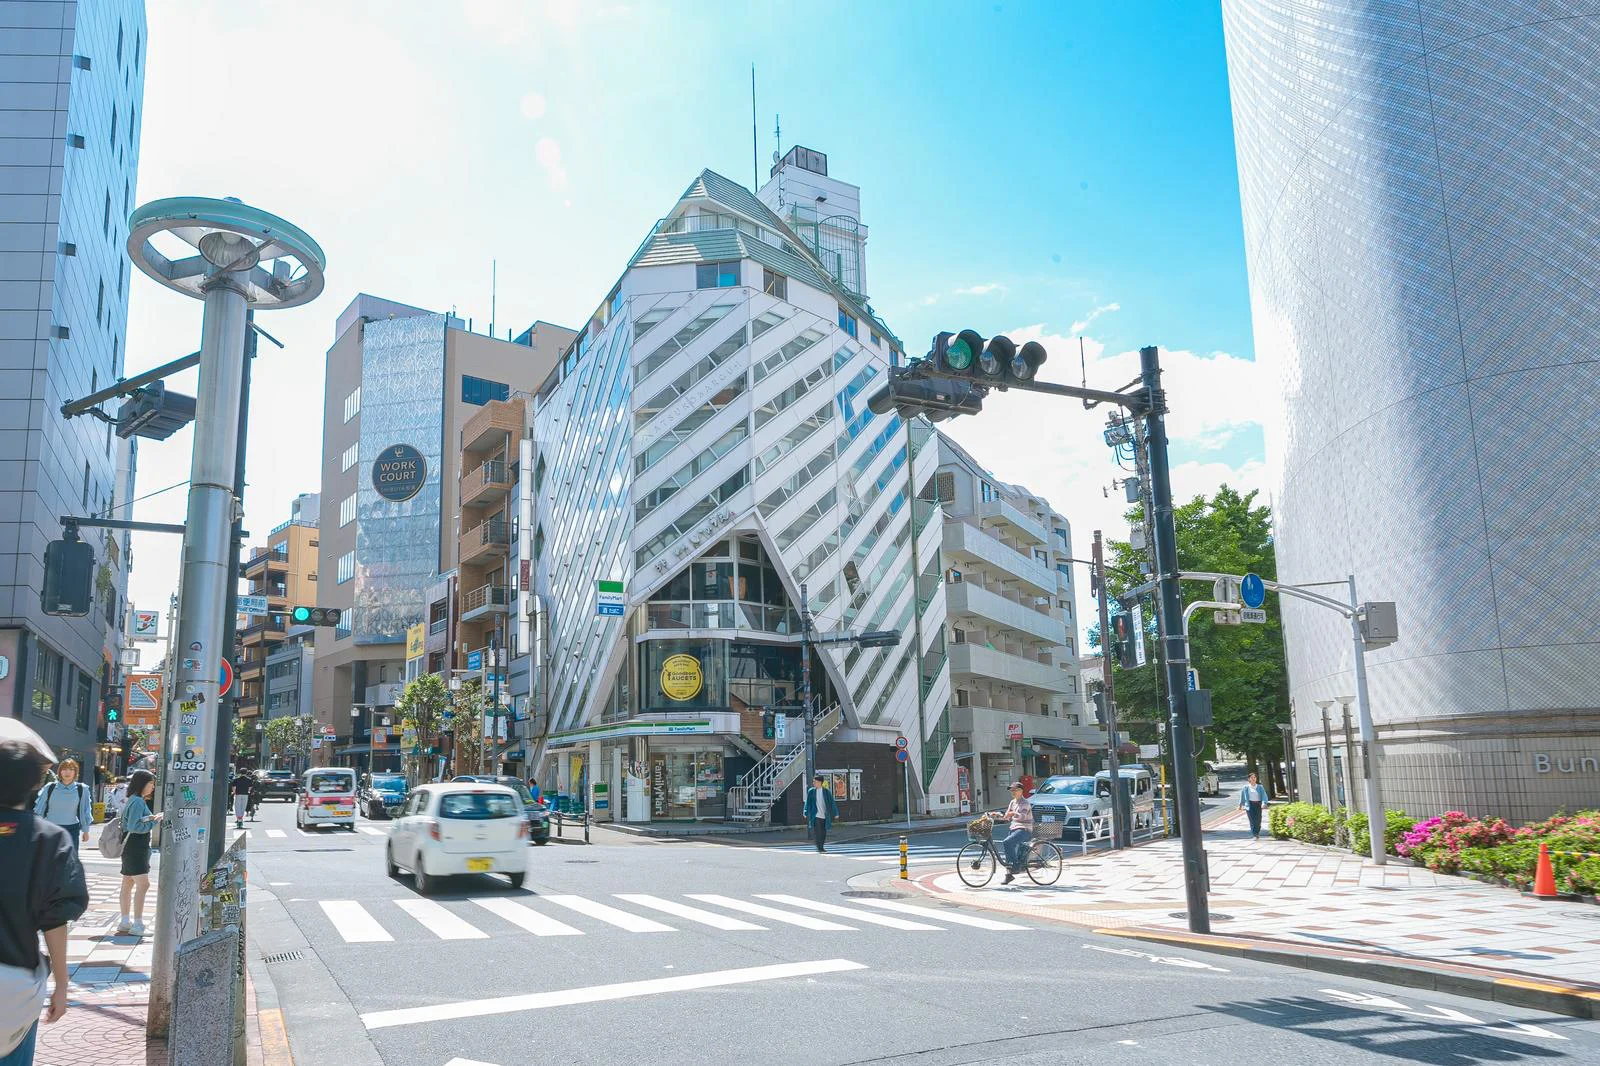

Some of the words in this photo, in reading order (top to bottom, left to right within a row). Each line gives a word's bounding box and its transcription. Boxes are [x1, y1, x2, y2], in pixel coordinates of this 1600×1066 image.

[381, 460, 416, 471] WORK
[380, 471, 416, 482] COURT
[173, 761, 205, 771] DEGO
[1535, 753, 1599, 773] Bun
[655, 759, 665, 816] FamilyMart
